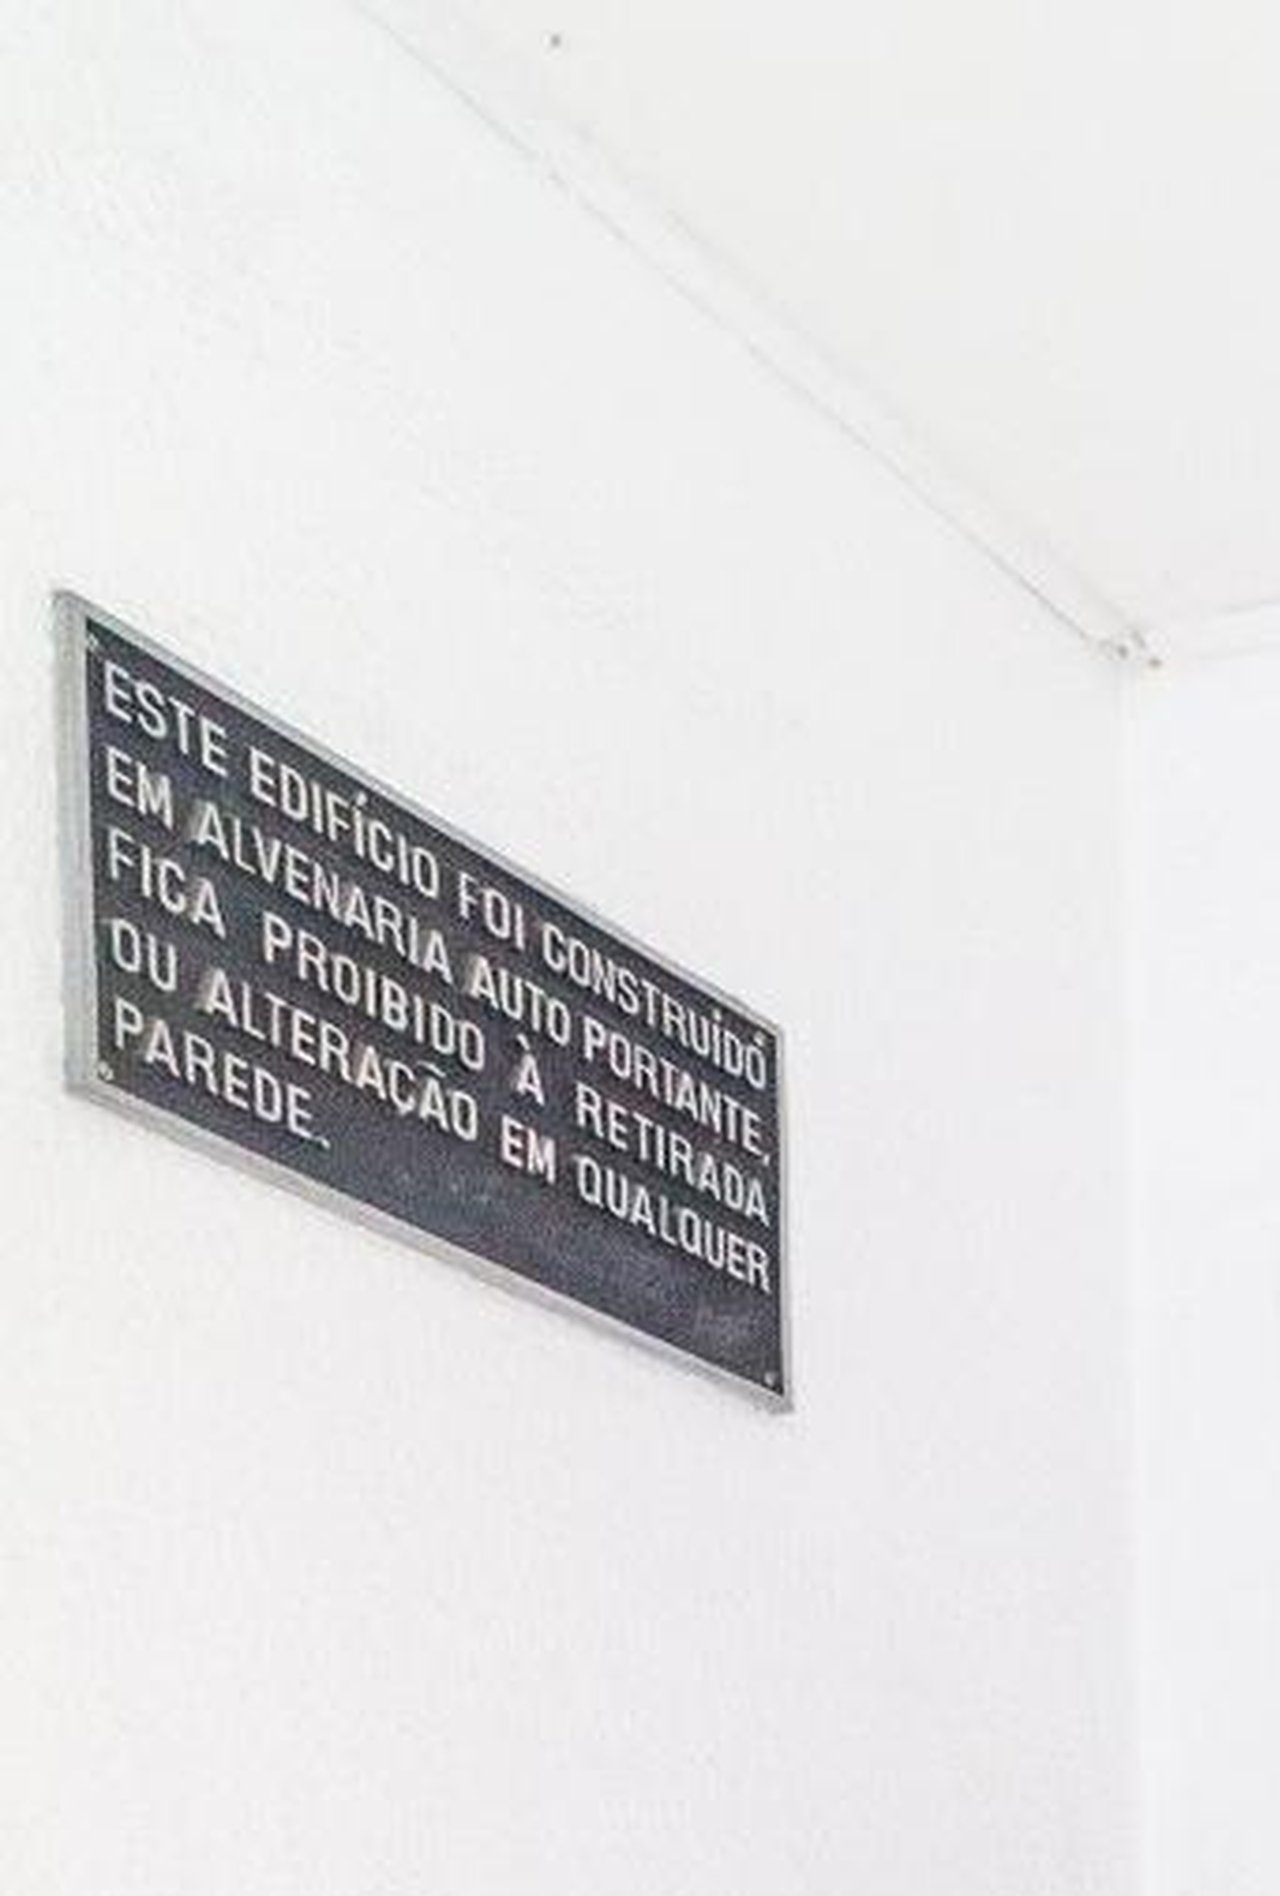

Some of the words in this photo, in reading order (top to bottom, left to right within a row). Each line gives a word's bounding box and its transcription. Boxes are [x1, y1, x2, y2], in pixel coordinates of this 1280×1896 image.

[104, 659, 229, 778] ESTE
[250, 747, 438, 899] EDIFÍCIO
[458, 870, 525, 950] FOI
[541, 921, 767, 1090] CONSTRUÍDO
[105, 745, 174, 830] EM
[194, 802, 453, 984] ALVENARIA
[468, 954, 571, 1047] AUTO
[582, 1015, 771, 1167] PORTANTE,
[106, 828, 228, 939] FICA
[262, 910, 486, 1072] PROIBIDO
[513, 1033, 545, 1106] À
[574, 1081, 771, 1229] RETIRADA
[110, 918, 178, 993] OU
[202, 967, 479, 1142] ALTERAÇÃO
[500, 1113, 558, 1184] EM
[575, 1153, 772, 1294] QUALQUER
